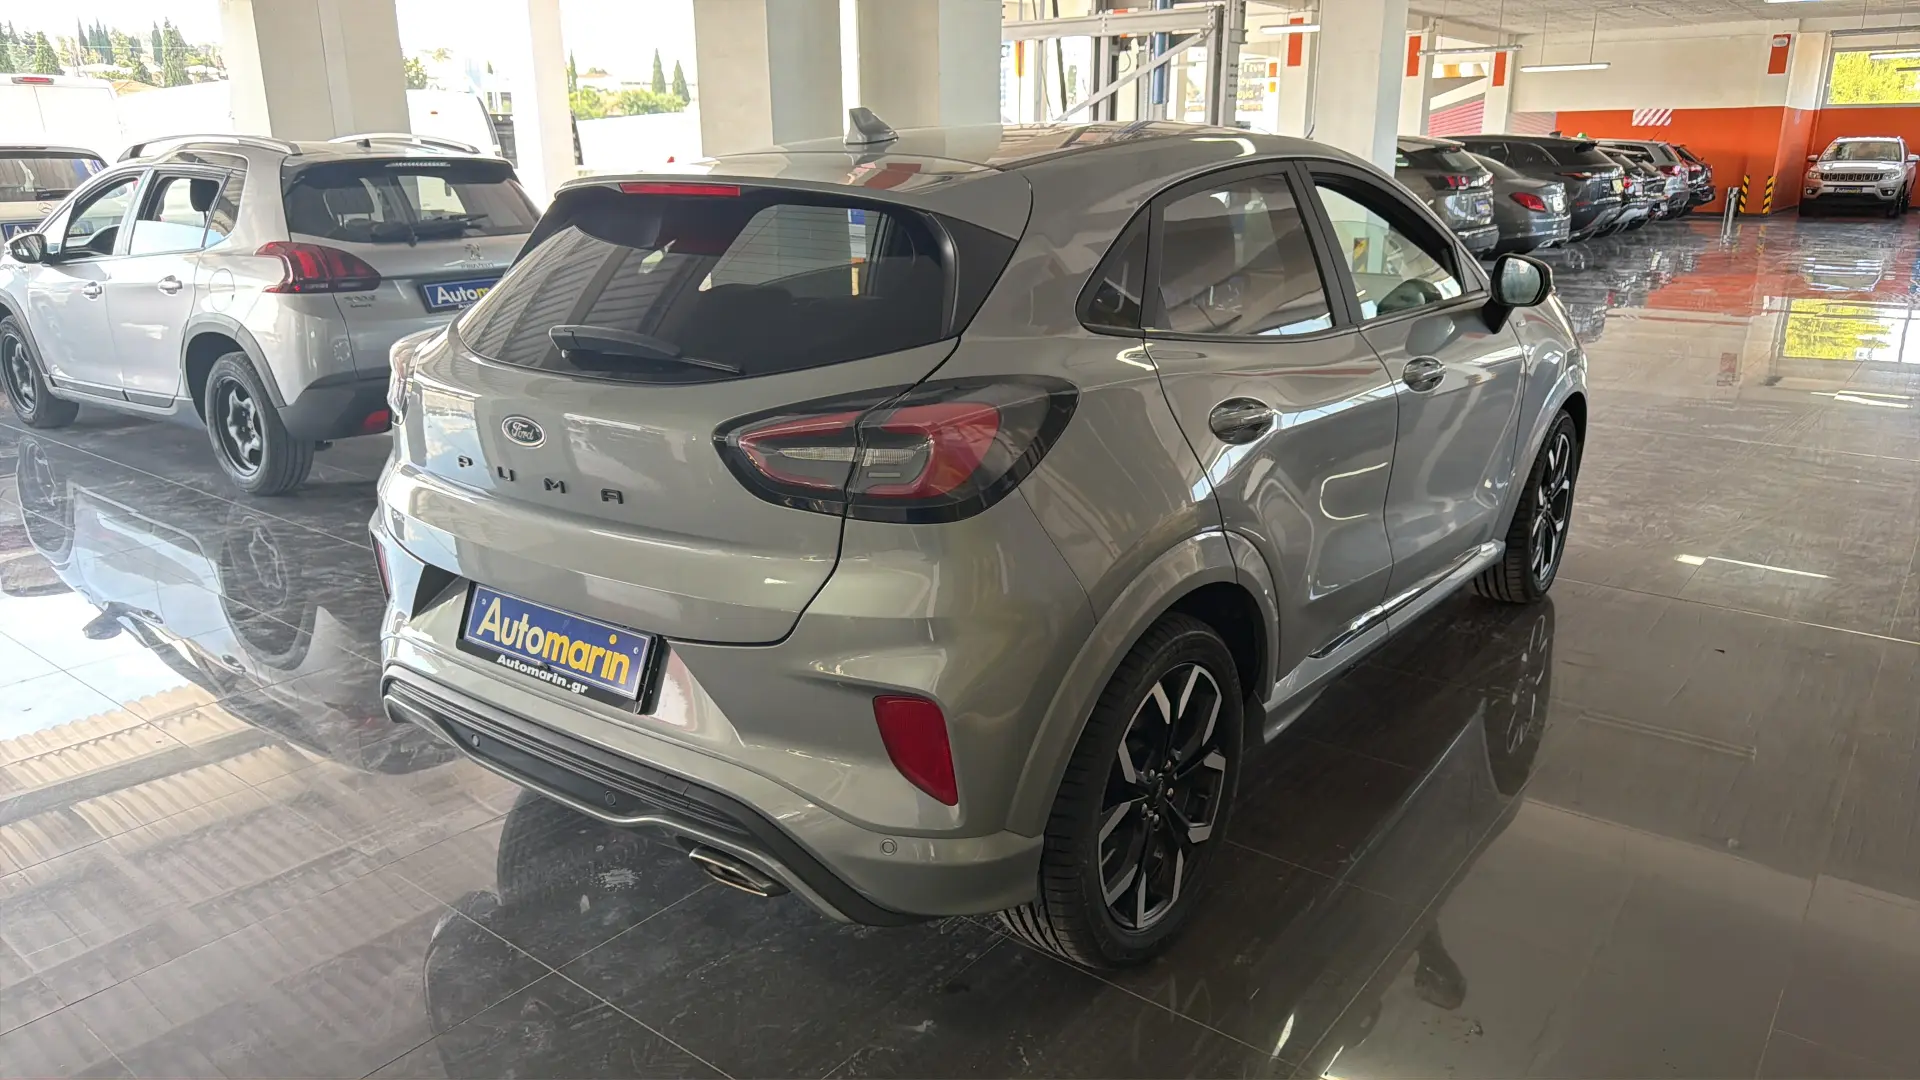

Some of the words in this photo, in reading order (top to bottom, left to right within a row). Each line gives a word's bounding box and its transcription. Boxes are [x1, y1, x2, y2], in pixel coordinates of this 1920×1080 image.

[437, 286, 490, 304] Autom
[511, 421, 534, 441] Ford
[458, 455, 624, 504] PUMA
[476, 597, 631, 685] Automarin
[496, 654, 589, 695] Automarin.gr
